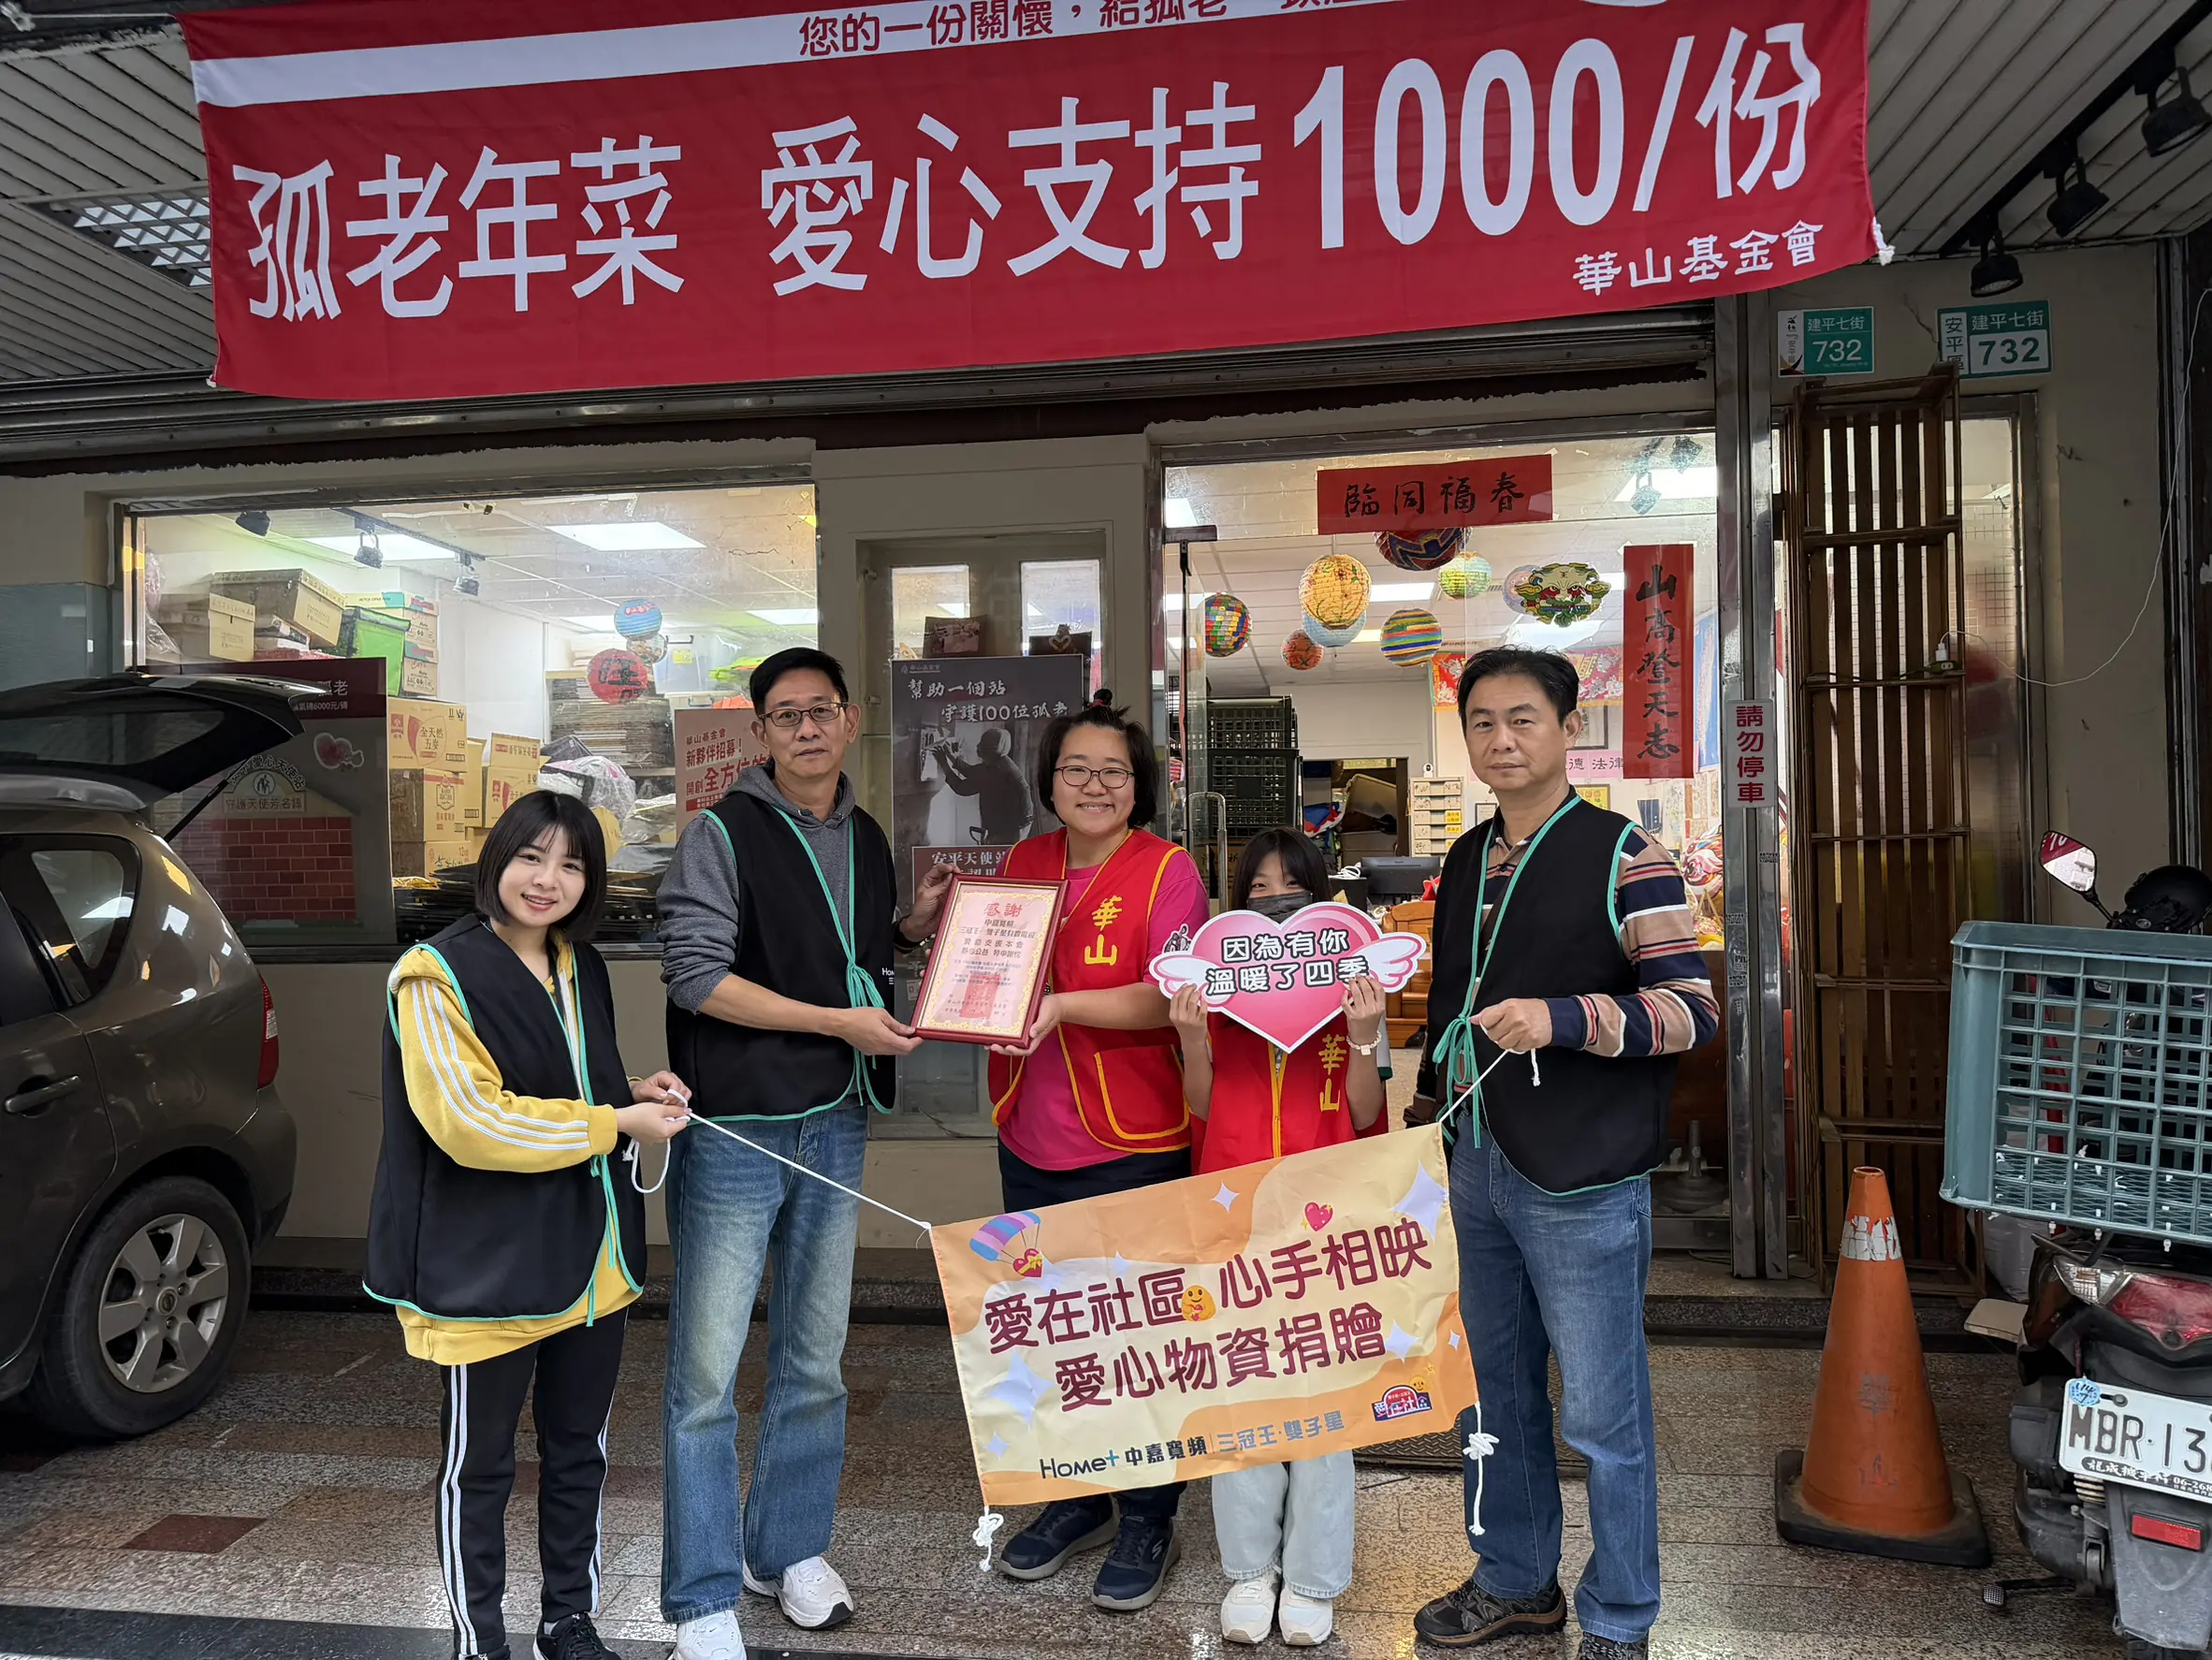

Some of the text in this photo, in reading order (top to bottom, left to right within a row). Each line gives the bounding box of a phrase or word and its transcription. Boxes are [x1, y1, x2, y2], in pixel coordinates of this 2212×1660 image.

[234, 135, 684, 322] 孤老年菜
[1573, 219, 1824, 296] 華山基金會
[1808, 315, 1865, 332] 建平七街
[1972, 310, 2045, 330] 建平七街
[1812, 339, 1862, 362] 732
[1979, 337, 2040, 366] 732
[909, 678, 1007, 700] 幫助一個站
[1736, 705, 1766, 804] 請勿停車
[983, 902, 1023, 917] 感謝
[1084, 895, 1123, 967] 華山
[1220, 927, 1350, 963] 因為有你
[1204, 955, 1371, 997] 溫暖了四季
[1318, 1033, 1347, 1113] 華山
[983, 1217, 1433, 1355] 愛在社區 心手相映
[1055, 1302, 1387, 1412] 愛心物資捐贈
[1125, 1435, 1207, 1467] 中嘉寬頻
